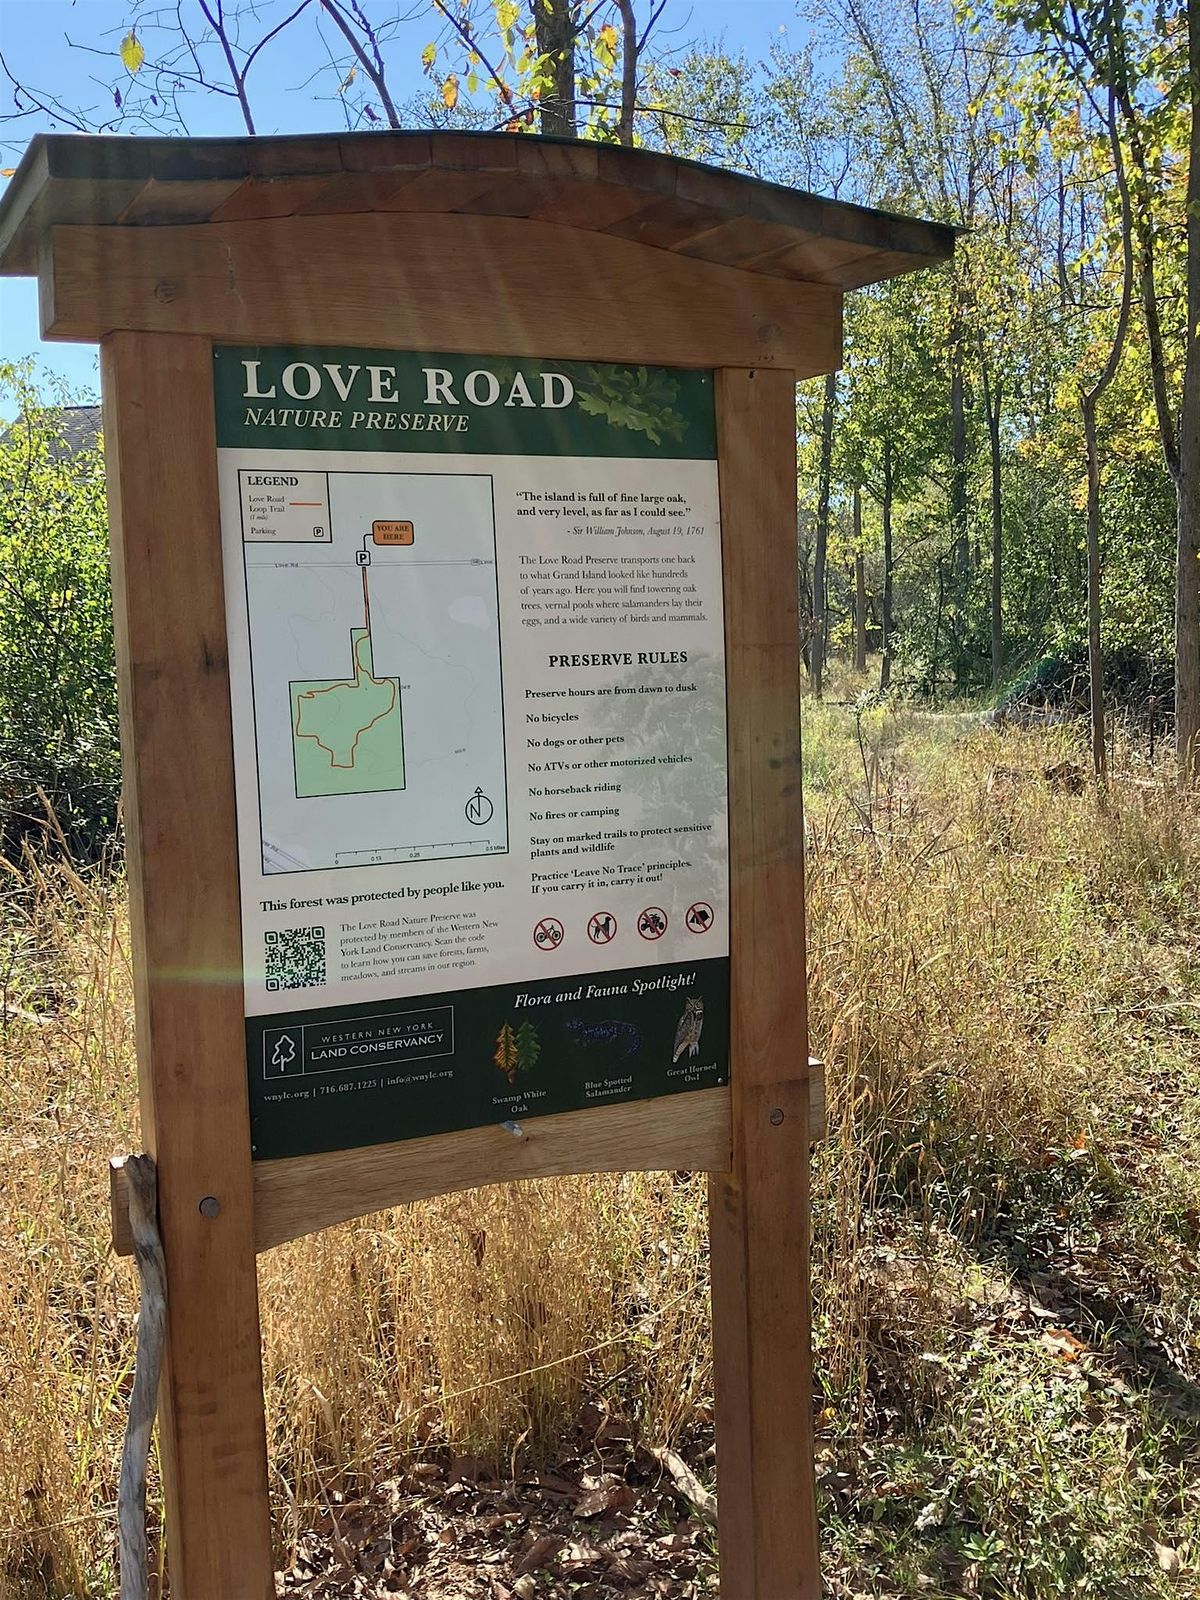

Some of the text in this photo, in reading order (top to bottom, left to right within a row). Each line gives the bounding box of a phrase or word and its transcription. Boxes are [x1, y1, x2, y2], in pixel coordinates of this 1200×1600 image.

[241, 360, 573, 408] LOVE ROAD
[244, 407, 469, 431] NATURE PRESERVE
[247, 476, 298, 486] LEGEND
[515, 491, 686, 505] “The island is full of fine large oak,
[516, 506, 536, 515] and
[538, 509, 560, 518] very
[562, 506, 589, 516] level,
[604, 506, 618, 516] far
[633, 507, 637, 516] I
[639, 507, 666, 516] could
[668, 507, 691, 516] see.”
[250, 526, 276, 536] Parking
[360, 553, 368, 564] P
[518, 555, 536, 564] The
[538, 555, 559, 564] Love
[561, 555, 583, 564] Road
[585, 555, 618, 564] Preserve
[620, 557, 660, 566] transports
[677, 554, 696, 563] back
[530, 570, 550, 579] what
[552, 570, 580, 579] Grand
[582, 570, 606, 579] Island
[608, 569, 635, 578] looked
[636, 569, 650, 578] like
[651, 569, 688, 578] hundreds
[519, 583, 697, 596] of years ago. Here you will find towering oak
[544, 600, 570, 609] vernal
[572, 600, 594, 611] pools
[595, 599, 620, 608] where
[621, 598, 670, 608] salamanders
[671, 598, 683, 608] lay
[684, 598, 703, 606] their
[521, 618, 542, 627] eggs,
[543, 615, 560, 624] and
[568, 614, 588, 623] wide
[590, 614, 617, 625] variety
[618, 614, 628, 622] of
[630, 613, 650, 622] birds
[651, 613, 667, 621] and
[668, 612, 708, 621] mammals.
[548, 651, 687, 667] PRESERVE RULES
[524, 689, 566, 698] Preserve
[568, 688, 595, 696] hours
[614, 686, 636, 694] from
[638, 684, 662, 693] dawn
[675, 683, 697, 691] dusk
[525, 712, 579, 724] No bicycles
[526, 738, 541, 747] No
[542, 738, 565, 748] dogs
[578, 735, 604, 744] other
[605, 736, 624, 745] pets
[527, 763, 541, 772] No
[543, 761, 570, 770] ATVs
[583, 759, 608, 768] other
[610, 756, 656, 766] motorized
[657, 754, 693, 763] vehicles
[528, 782, 621, 796] No horseback riding
[529, 812, 543, 820] No
[545, 810, 566, 819] fires
[580, 806, 619, 818] camping
[530, 836, 550, 846] Stay
[566, 831, 601, 842] marked
[603, 829, 627, 838] trails
[640, 827, 672, 838] protect
[673, 823, 712, 833] sensitive
[530, 842, 615, 860] plants and wildlife
[531, 870, 569, 881] Practice
[570, 869, 600, 877] ‘Leave
[602, 866, 615, 874] No
[616, 862, 645, 873] Trace’
[531, 871, 663, 894] If you carry it in, carry it out!
[259, 881, 505, 911] This forest was protected by people like you.
[514, 972, 696, 1008] Flora and Fauna Spotlight!
[321, 1022, 433, 1042] WESTERN NEW YORK
[310, 1033, 445, 1061] LAND CONSERVANCY
[666, 1062, 717, 1076] Great Horned
[263, 1069, 454, 1102] wnylc.org 716.687.1225 info@wnylc.org
[584, 1075, 633, 1090] Blue Spotted
[492, 1090, 546, 1104] Swamp White
[584, 1085, 633, 1098] Salamander
[510, 1104, 528, 1112] Oak
